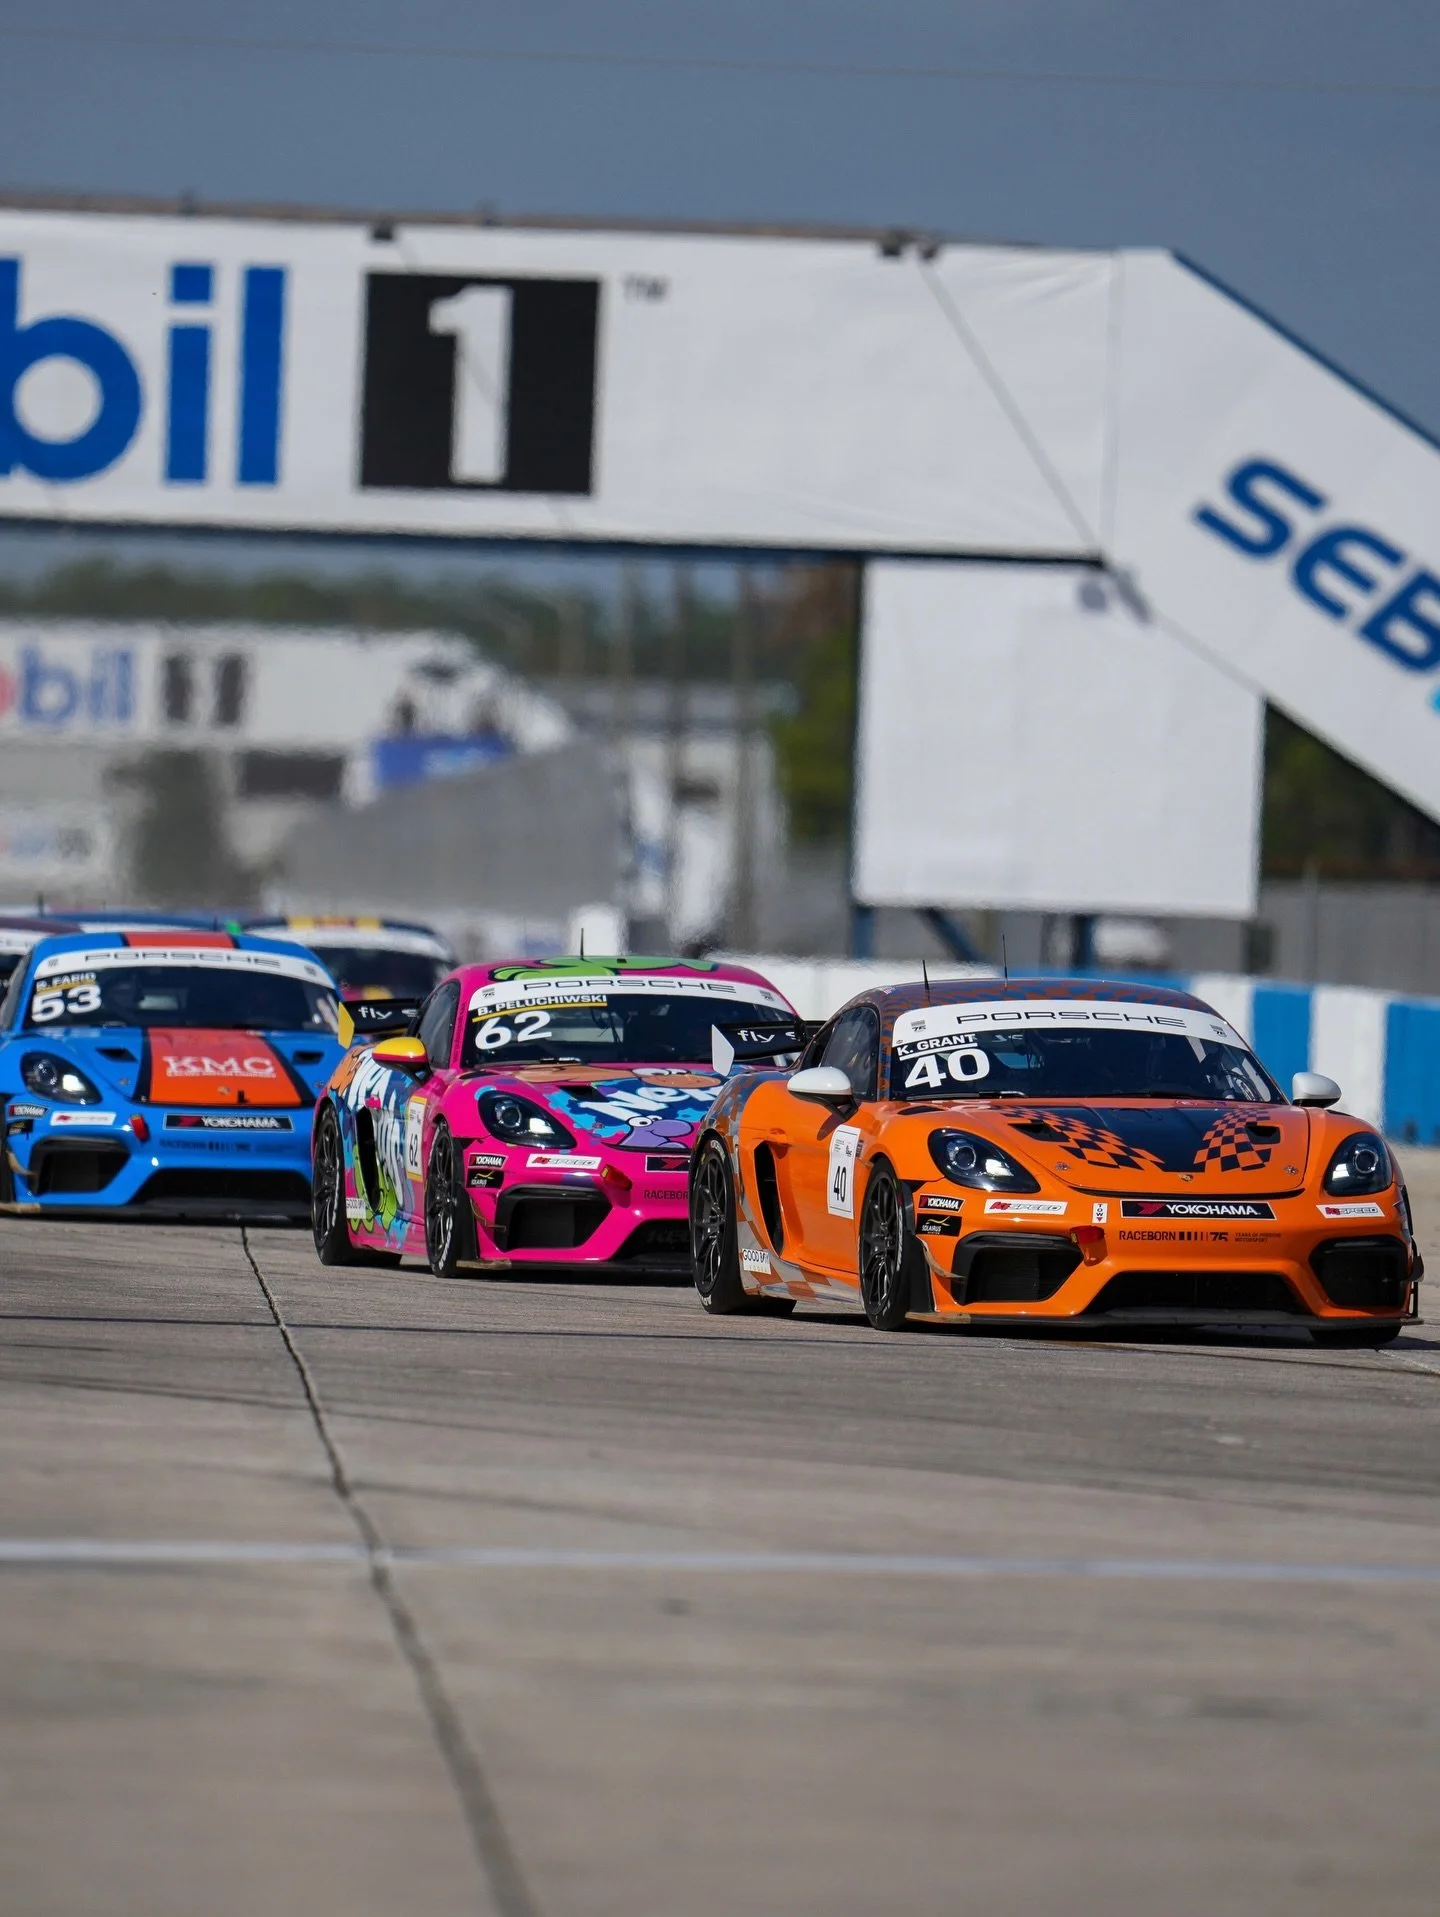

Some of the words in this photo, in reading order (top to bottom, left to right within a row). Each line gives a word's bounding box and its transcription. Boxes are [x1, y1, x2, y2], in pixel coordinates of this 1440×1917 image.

[428, 285, 514, 483] 1
[1193, 457, 1440, 675] SEB
[85, 952, 281, 969] PORSCHE
[524, 979, 737, 993] PORSCHE
[31, 984, 102, 1023] 53
[358, 1005, 393, 1020] fly
[477, 1006, 492, 1017] B.
[496, 994, 607, 1012] PELUCHIWSKI
[956, 1011, 1187, 1028] PORSCHE
[474, 1011, 553, 1050] 62
[737, 1029, 775, 1043] fly
[896, 1044, 914, 1057] K.
[917, 1033, 976, 1051] GRANT
[162, 1055, 274, 1075] KMC
[904, 1048, 990, 1089] 40
[201, 1116, 281, 1128] YOKOHAMA
[833, 1165, 847, 1203] 40
[927, 1197, 959, 1210] YOKOHAMA
[1166, 1203, 1258, 1216] YOKOHAMA
[1119, 1230, 1176, 1241] RACEBORN
[1209, 1231, 1229, 1242] 75
